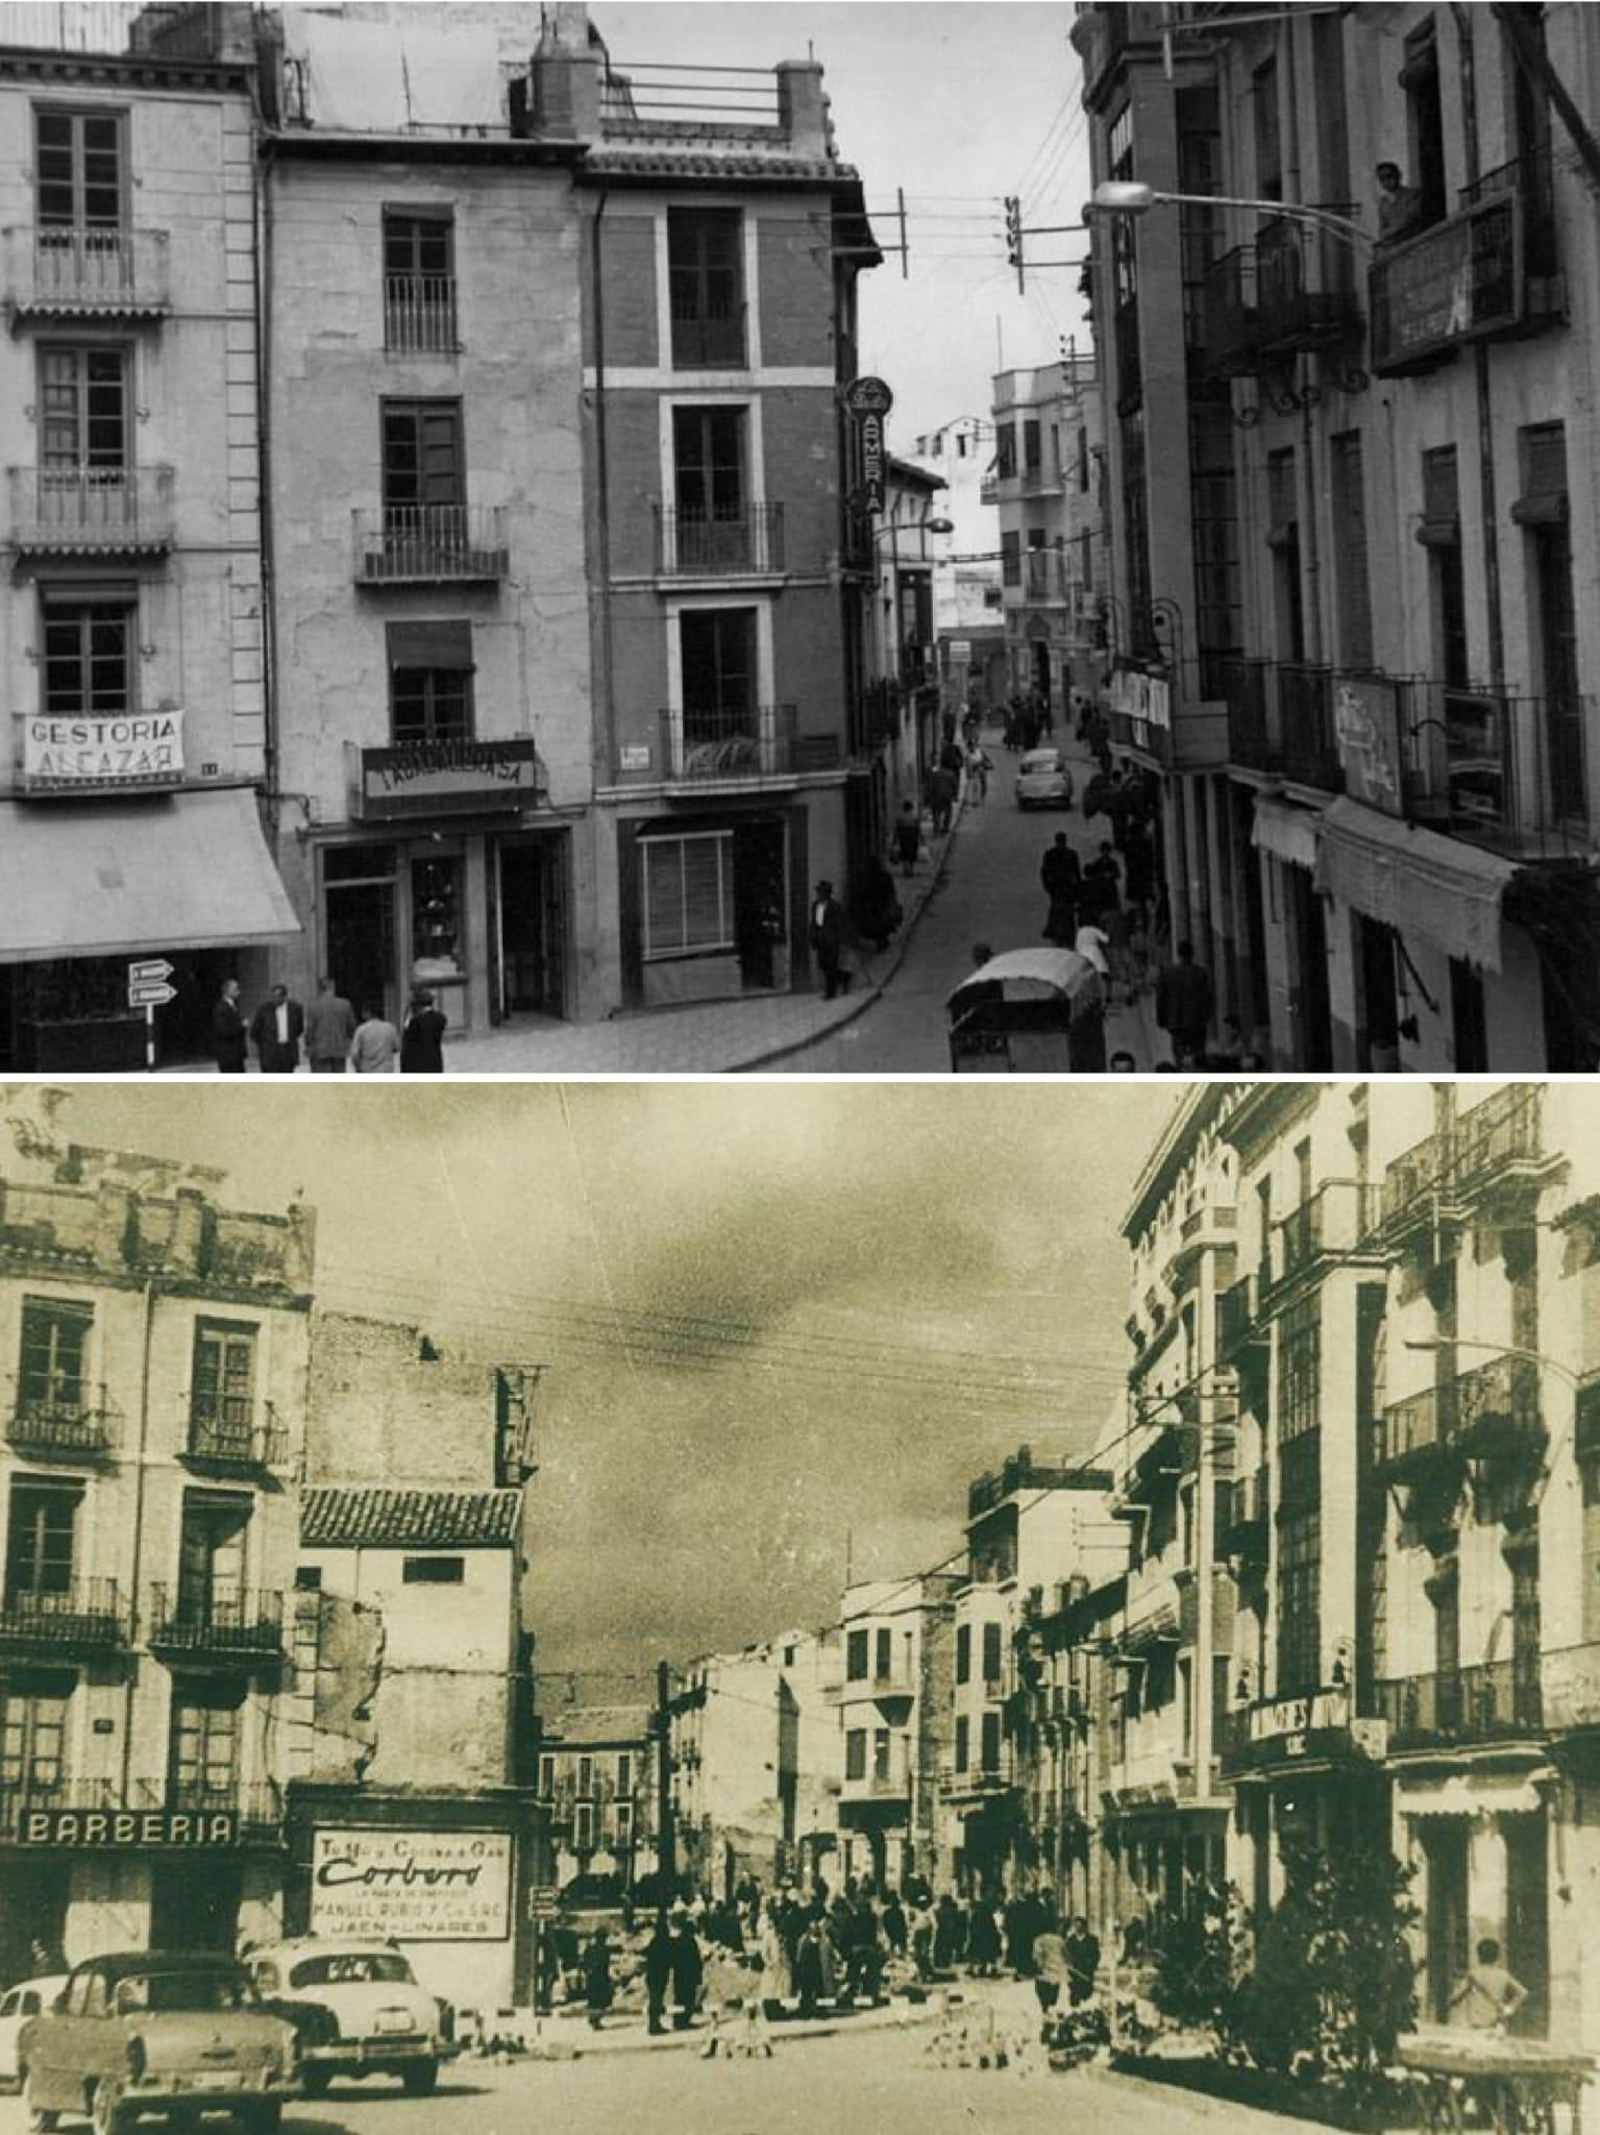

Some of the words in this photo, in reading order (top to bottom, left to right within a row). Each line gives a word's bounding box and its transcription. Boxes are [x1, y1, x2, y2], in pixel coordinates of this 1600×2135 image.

[864, 415, 881, 514] ARMERIA
[32, 718, 175, 744] GESTORIA
[38, 745, 172, 774] ALCAZAR
[28, 1813, 232, 1842] BARBERIA
